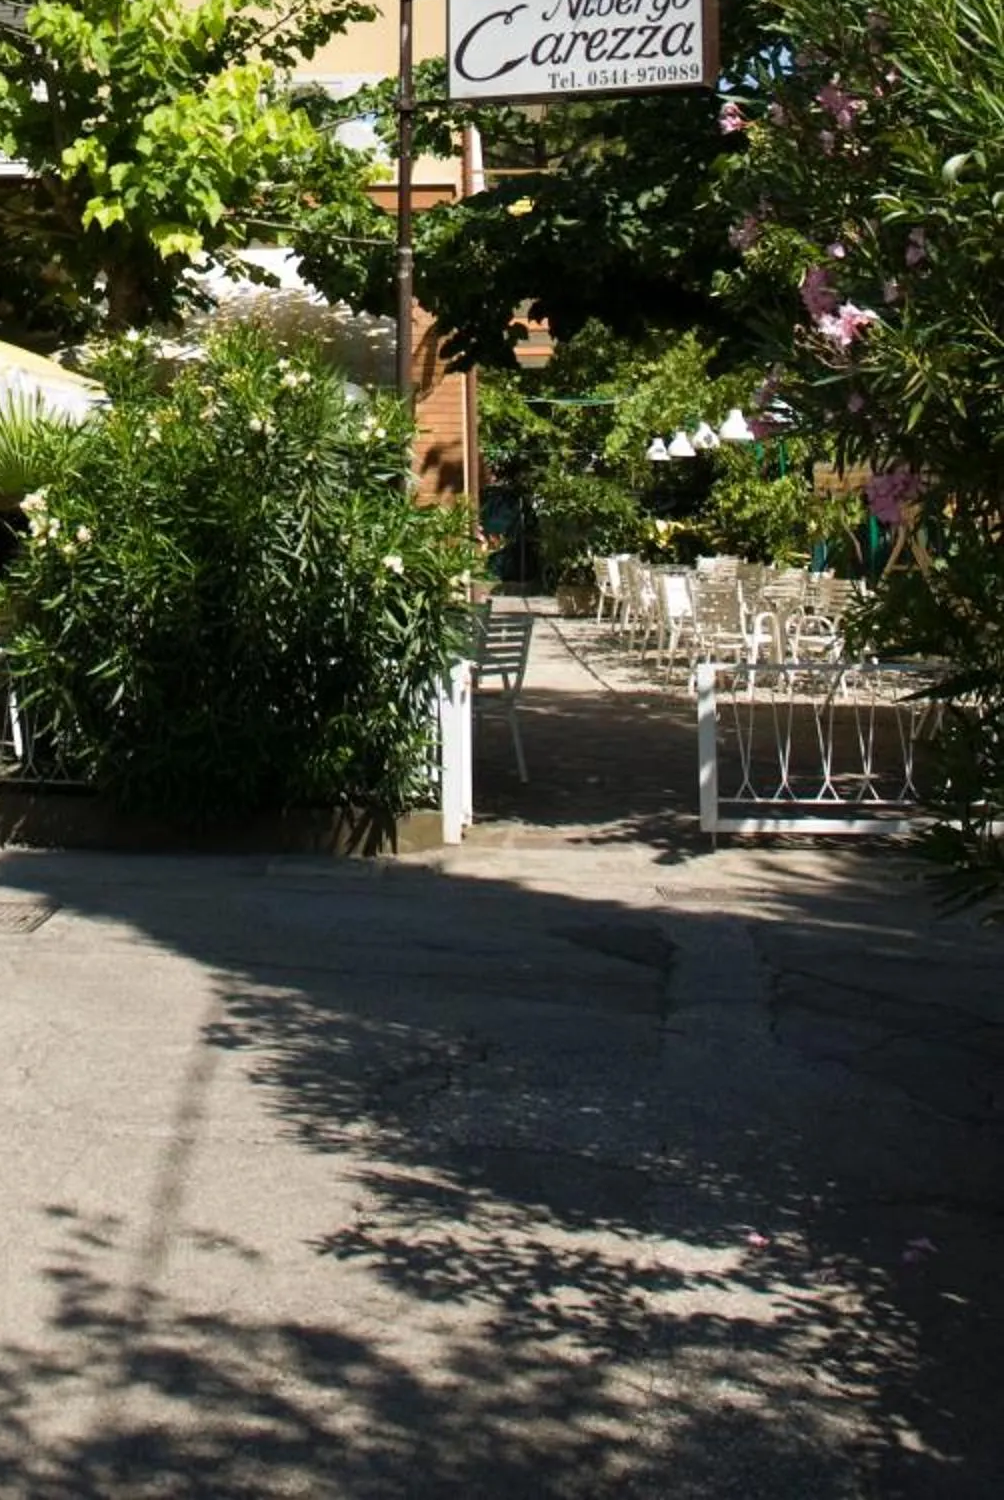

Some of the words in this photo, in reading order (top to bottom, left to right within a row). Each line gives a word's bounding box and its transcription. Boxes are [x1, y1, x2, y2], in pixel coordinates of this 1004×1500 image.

[454, 4, 696, 82] Carezza
[548, 72, 581, 89] Tel.
[588, 63, 700, 86] 0544-970989
